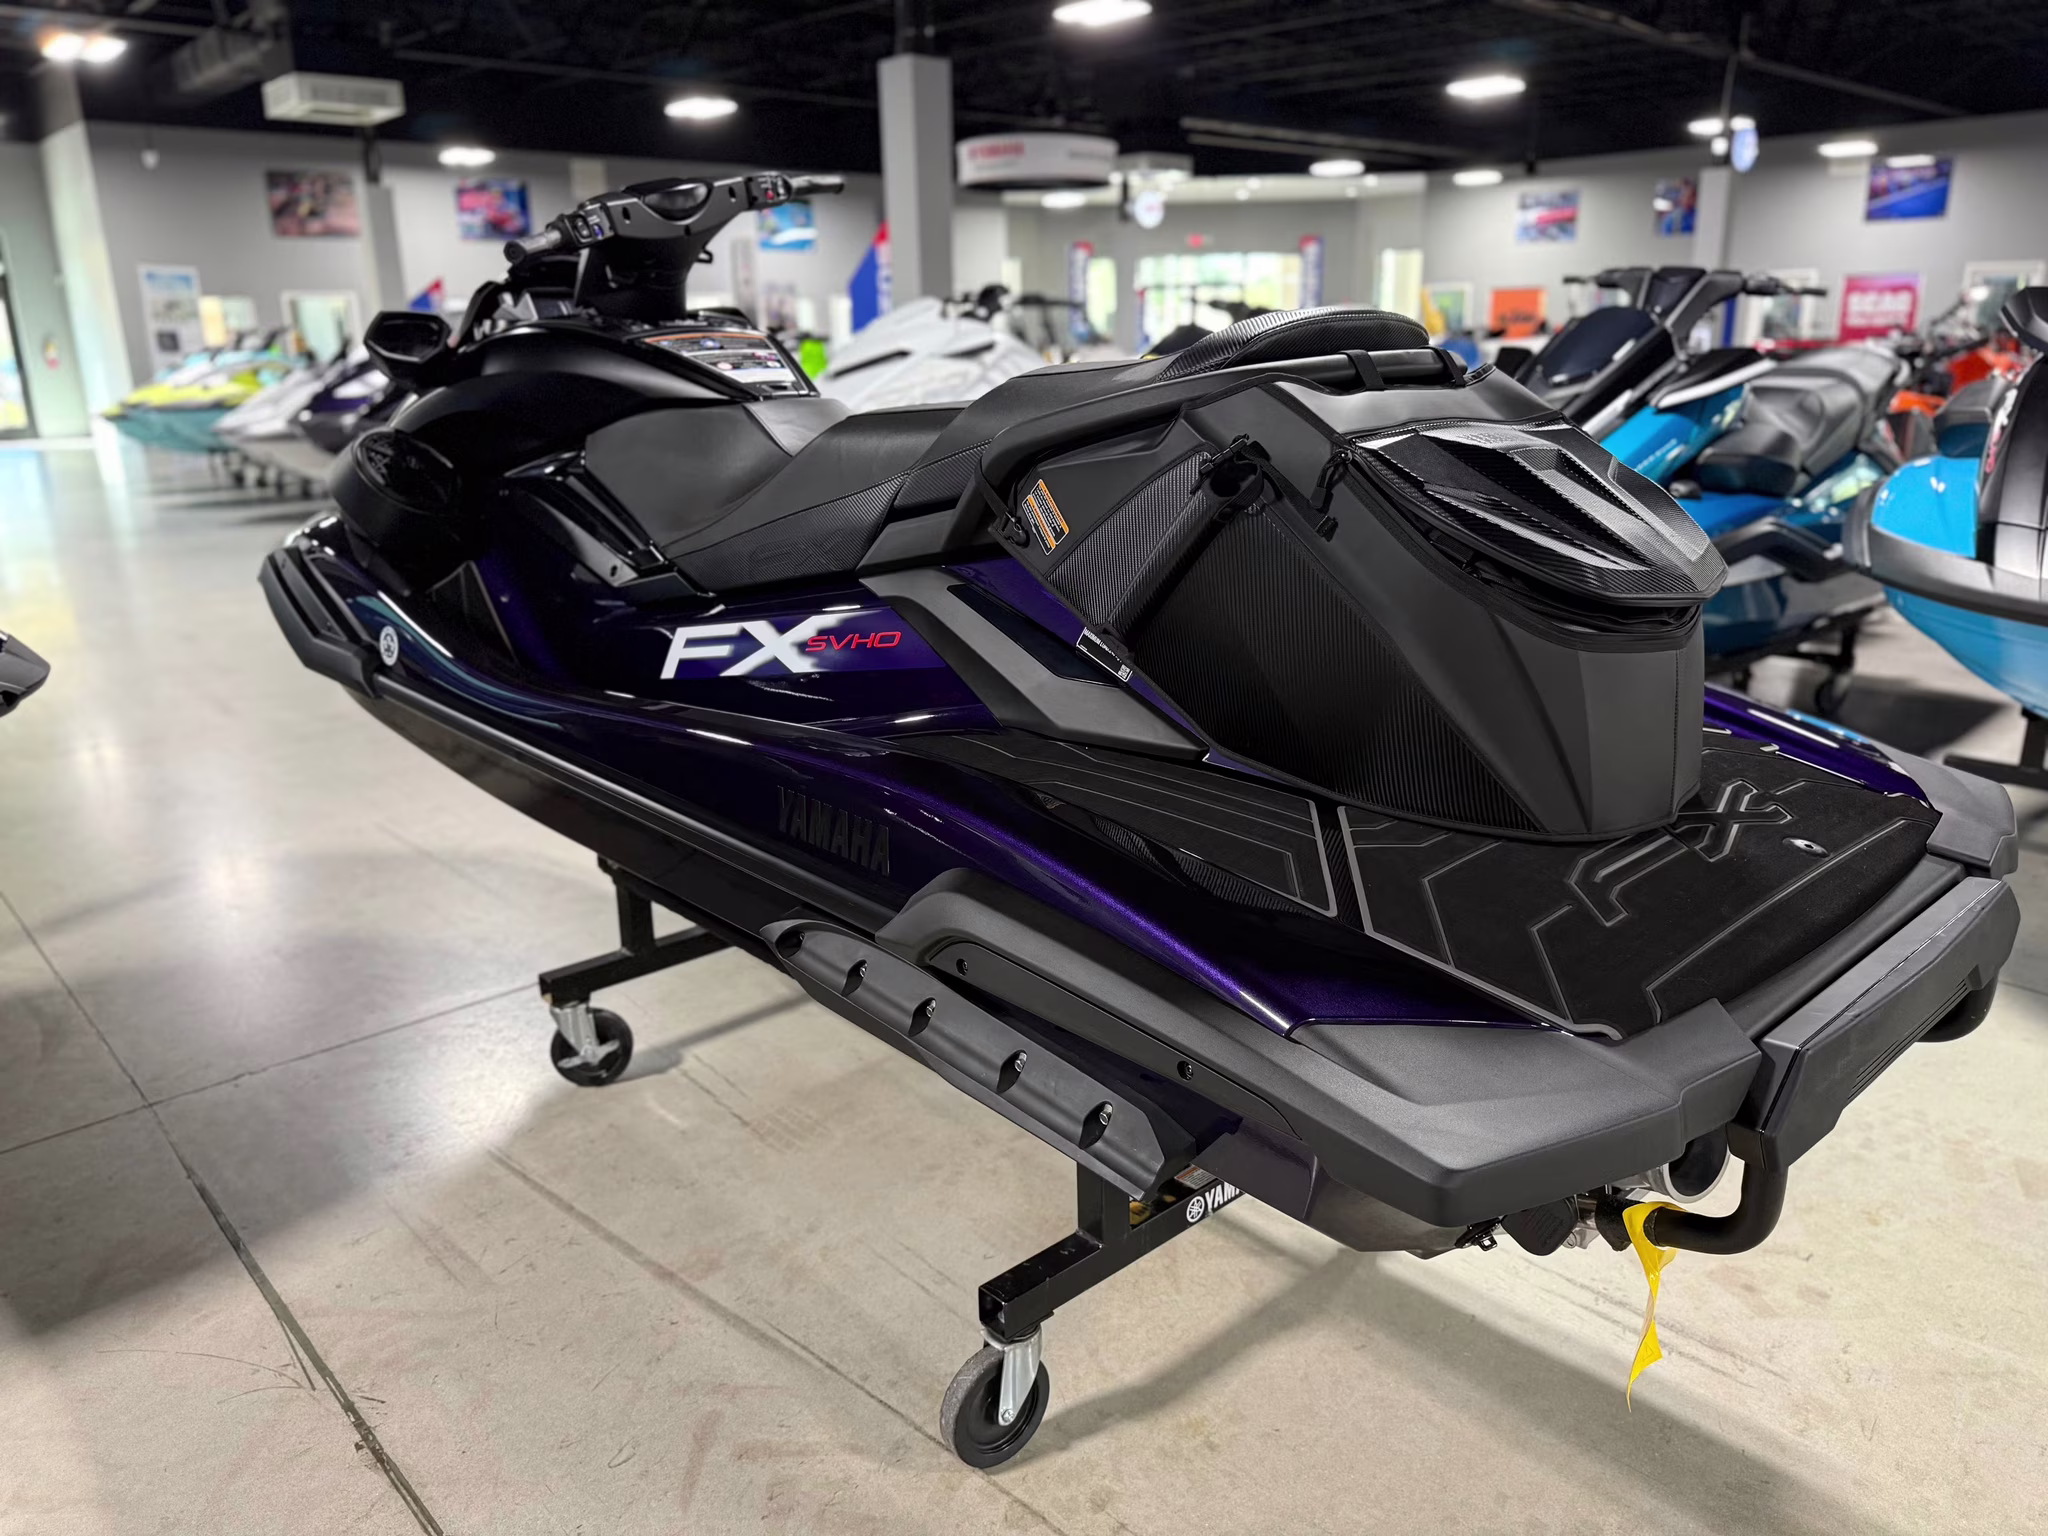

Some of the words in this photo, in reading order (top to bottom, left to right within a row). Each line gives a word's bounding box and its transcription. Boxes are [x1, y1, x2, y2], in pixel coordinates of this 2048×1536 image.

[660, 610, 883, 680] FX
[805, 631, 902, 652] SVHO
[777, 785, 890, 876] YAMAHA
[1205, 1182, 1241, 1212] YAM
